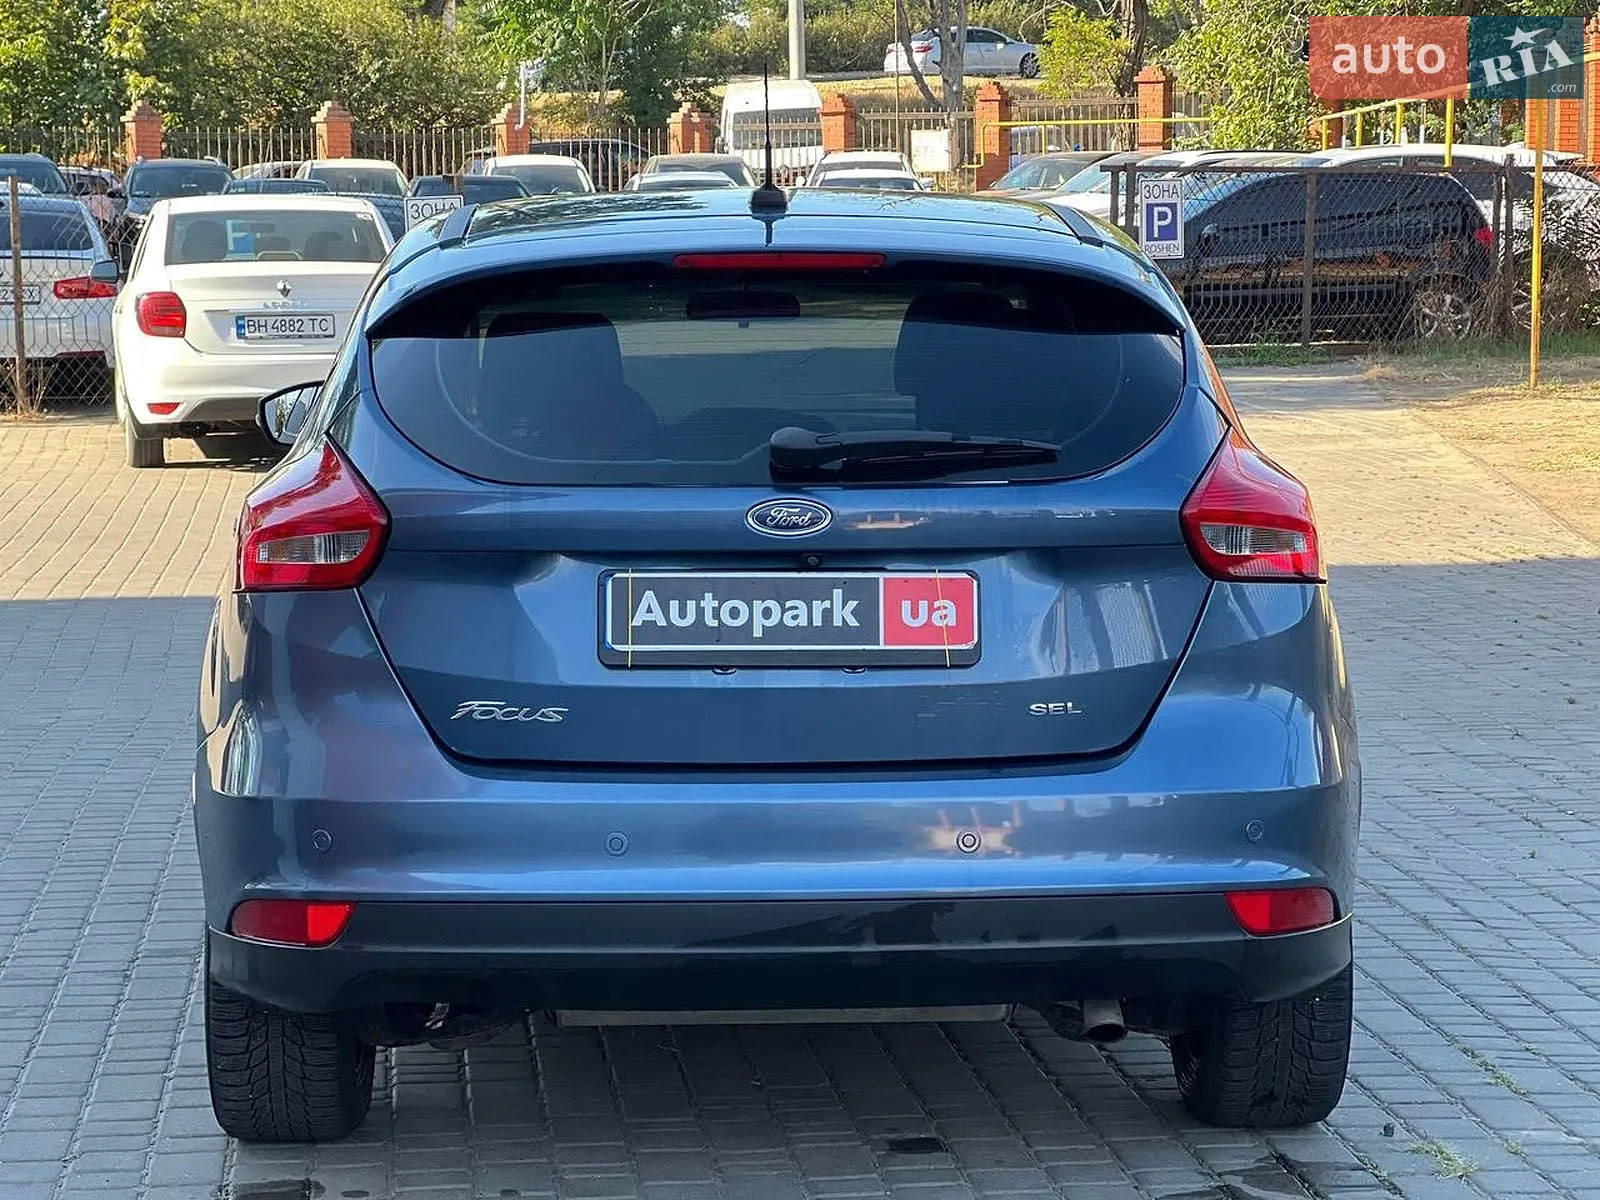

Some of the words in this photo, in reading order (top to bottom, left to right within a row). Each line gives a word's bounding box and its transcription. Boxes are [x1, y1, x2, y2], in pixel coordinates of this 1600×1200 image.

[1143, 184, 1180, 200] ЗОНА
[247, 319, 268, 334] BH
[271, 318, 305, 333] 4882
[308, 318, 329, 332] TC
[765, 507, 812, 526] Ford
[631, 589, 860, 638] Autopark
[901, 599, 957, 627] ua
[1029, 701, 1082, 716] SEL
